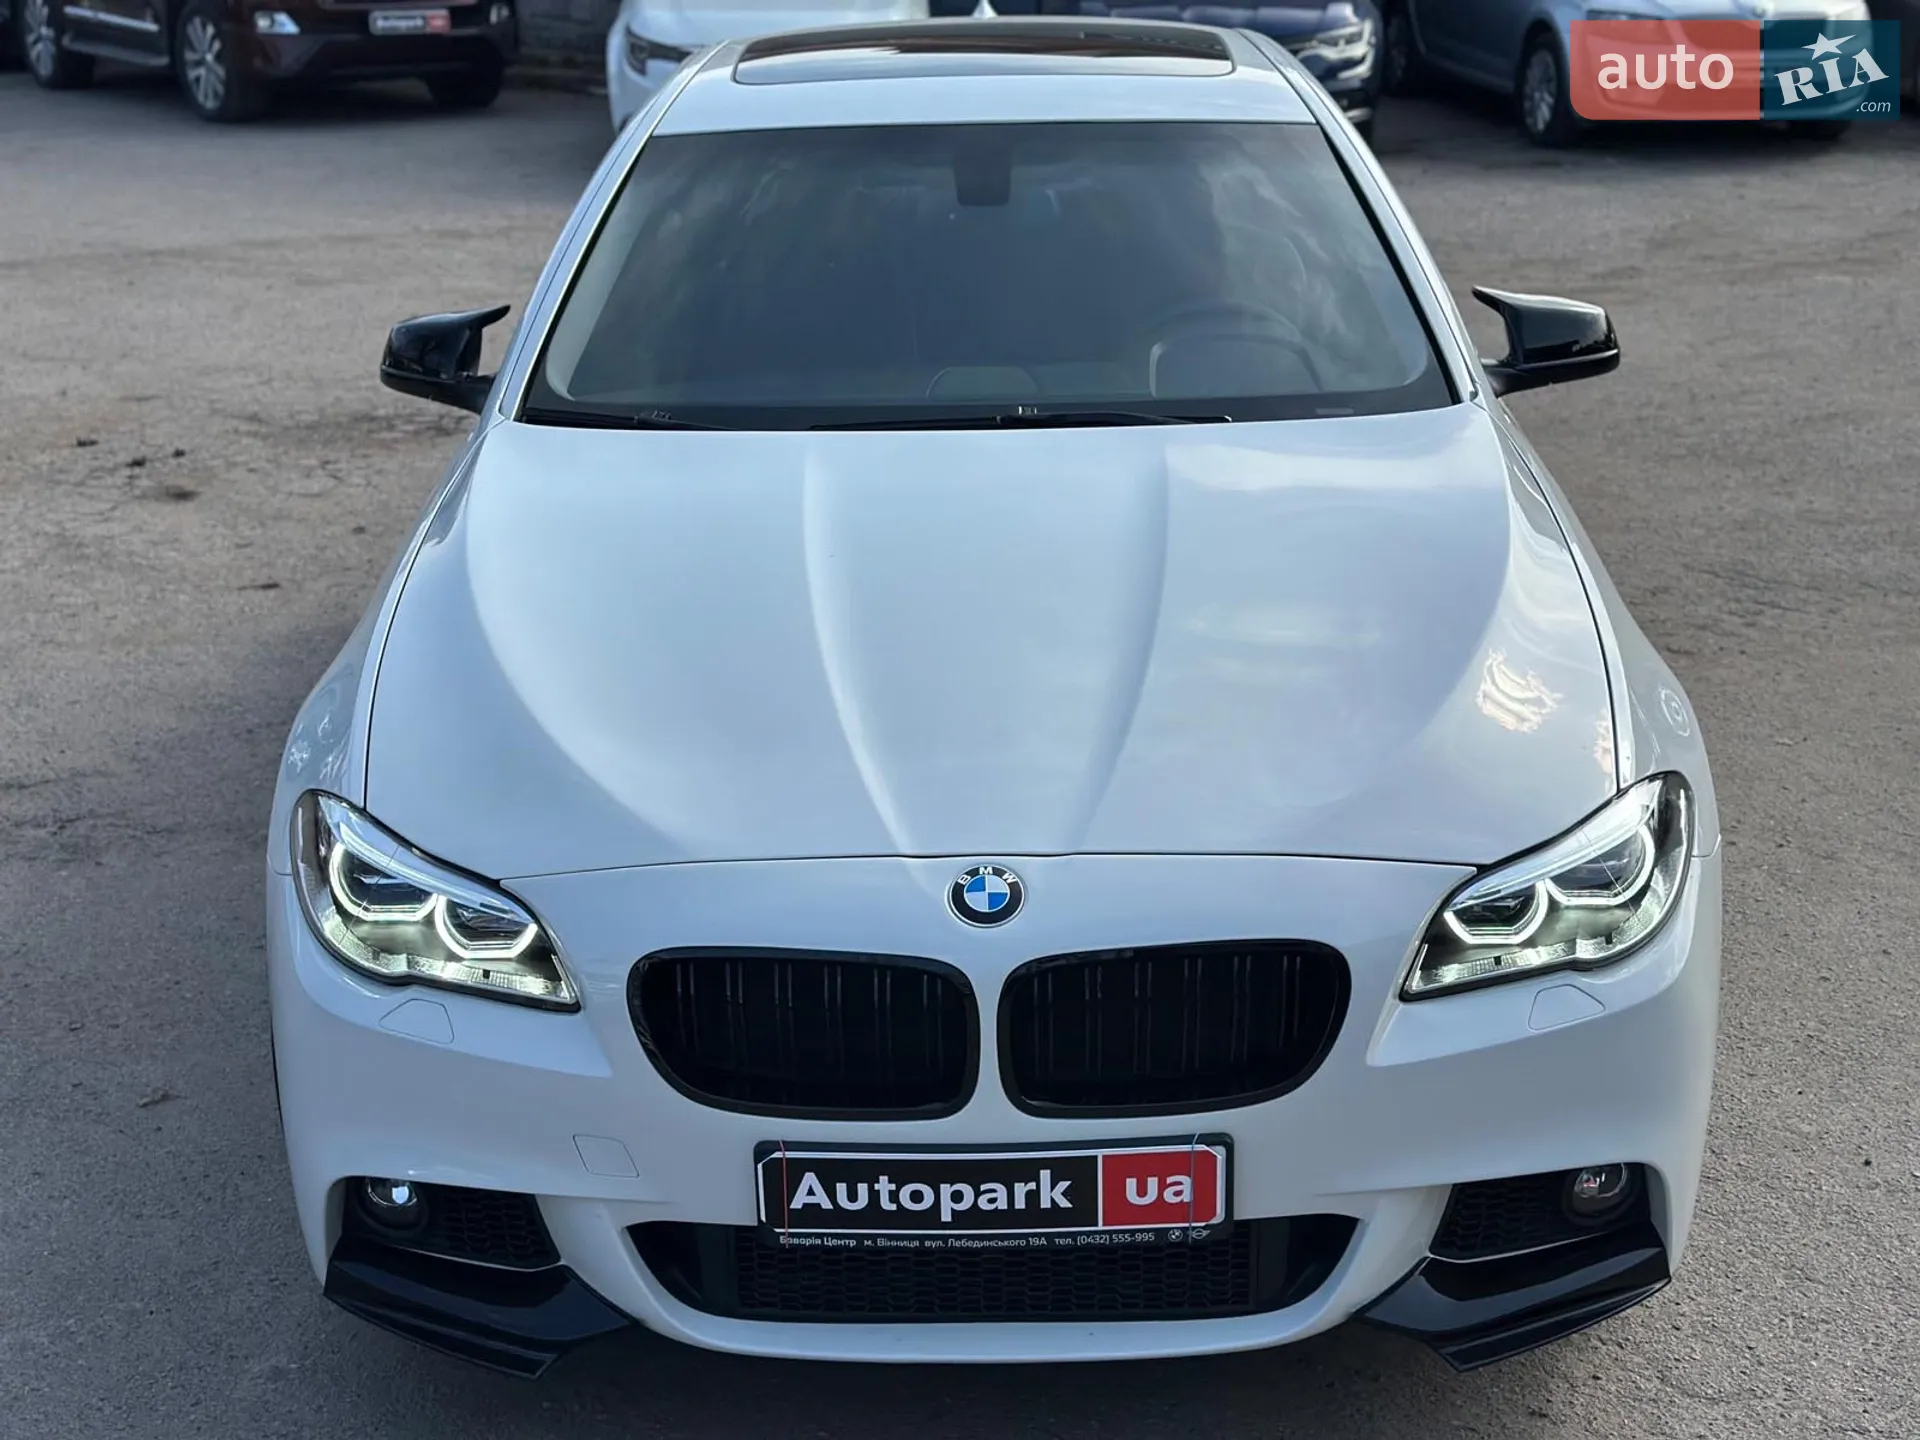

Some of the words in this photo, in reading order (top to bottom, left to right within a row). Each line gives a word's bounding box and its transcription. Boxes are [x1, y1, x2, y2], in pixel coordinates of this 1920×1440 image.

[957, 866, 1018, 885] BMW
[789, 1169, 1073, 1222] Autopark
[1125, 1173, 1192, 1206] ua
[823, 1236, 857, 1248] Центр
[877, 1238, 920, 1248] Вінниця
[947, 1238, 1026, 1249] Лебединського
[1053, 1237, 1075, 1246] тел.
[1077, 1234, 1110, 1246] (0432)
[1112, 1231, 1155, 1244] 555-995
